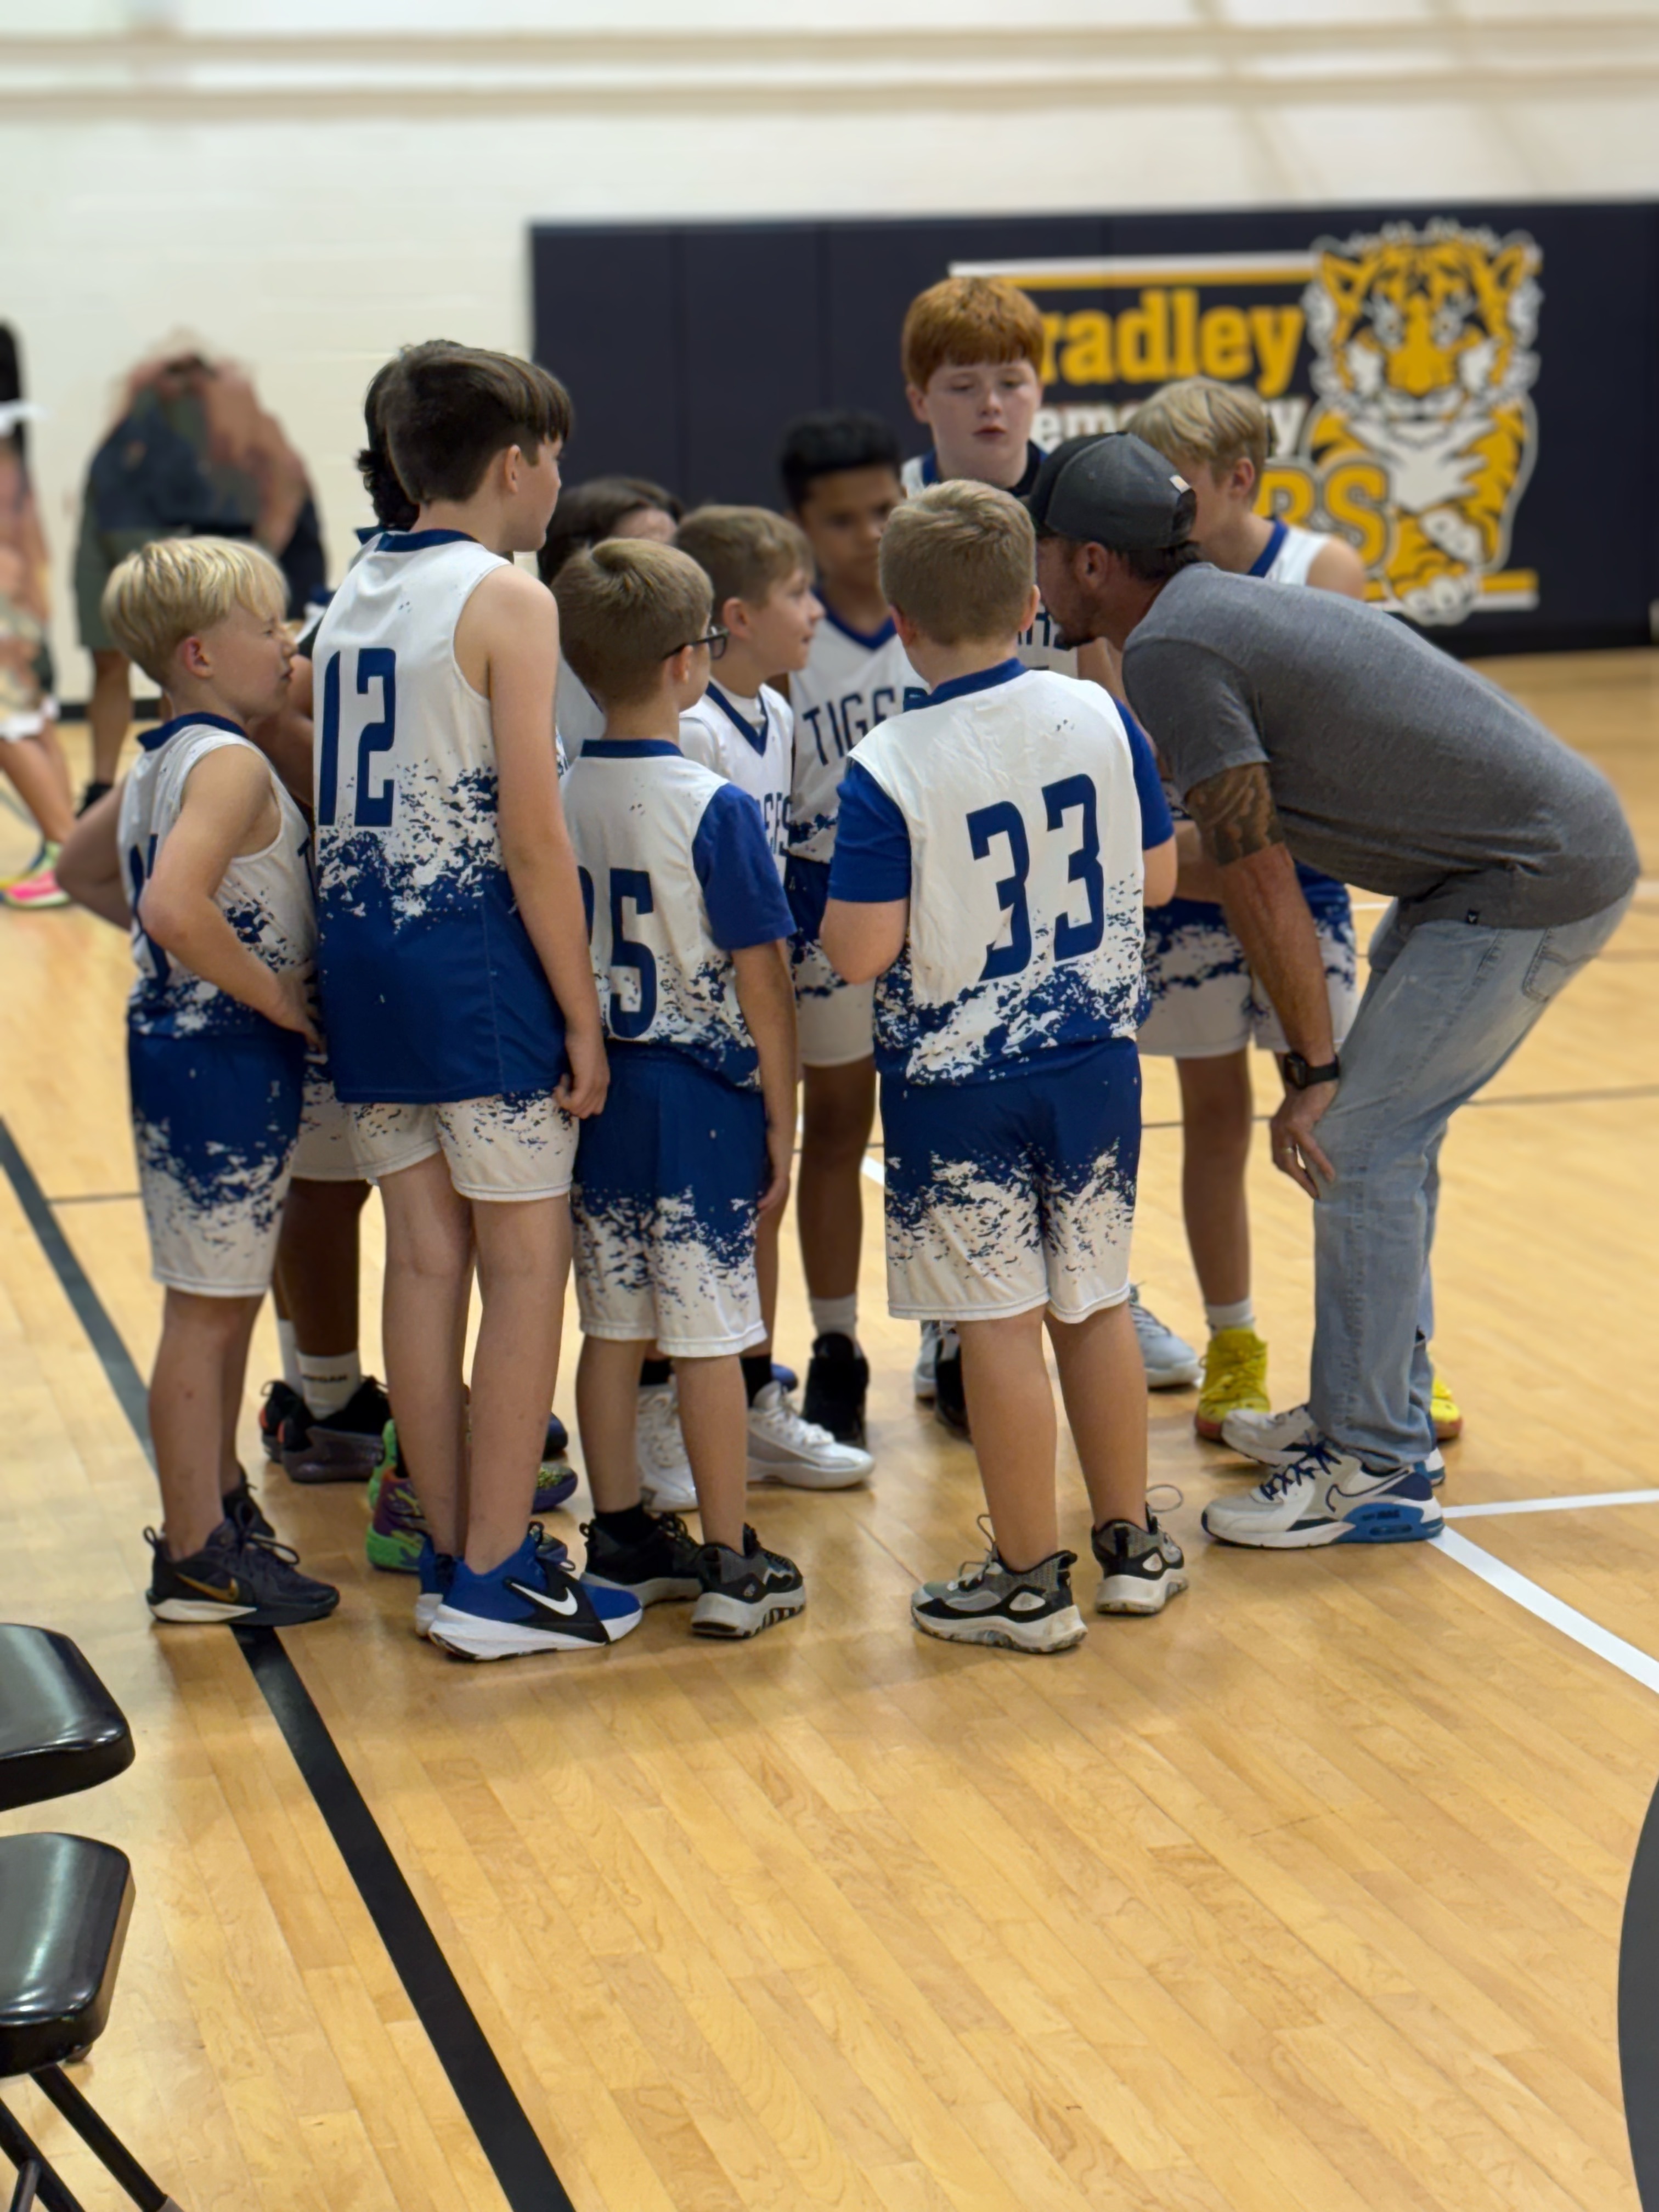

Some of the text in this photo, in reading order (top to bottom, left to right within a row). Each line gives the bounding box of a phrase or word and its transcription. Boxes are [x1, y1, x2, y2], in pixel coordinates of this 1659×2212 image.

[1041, 287, 1305, 397] radley
[318, 647, 397, 827] 12
[577, 865, 657, 1039] 5
[966, 773, 1104, 981] 33
